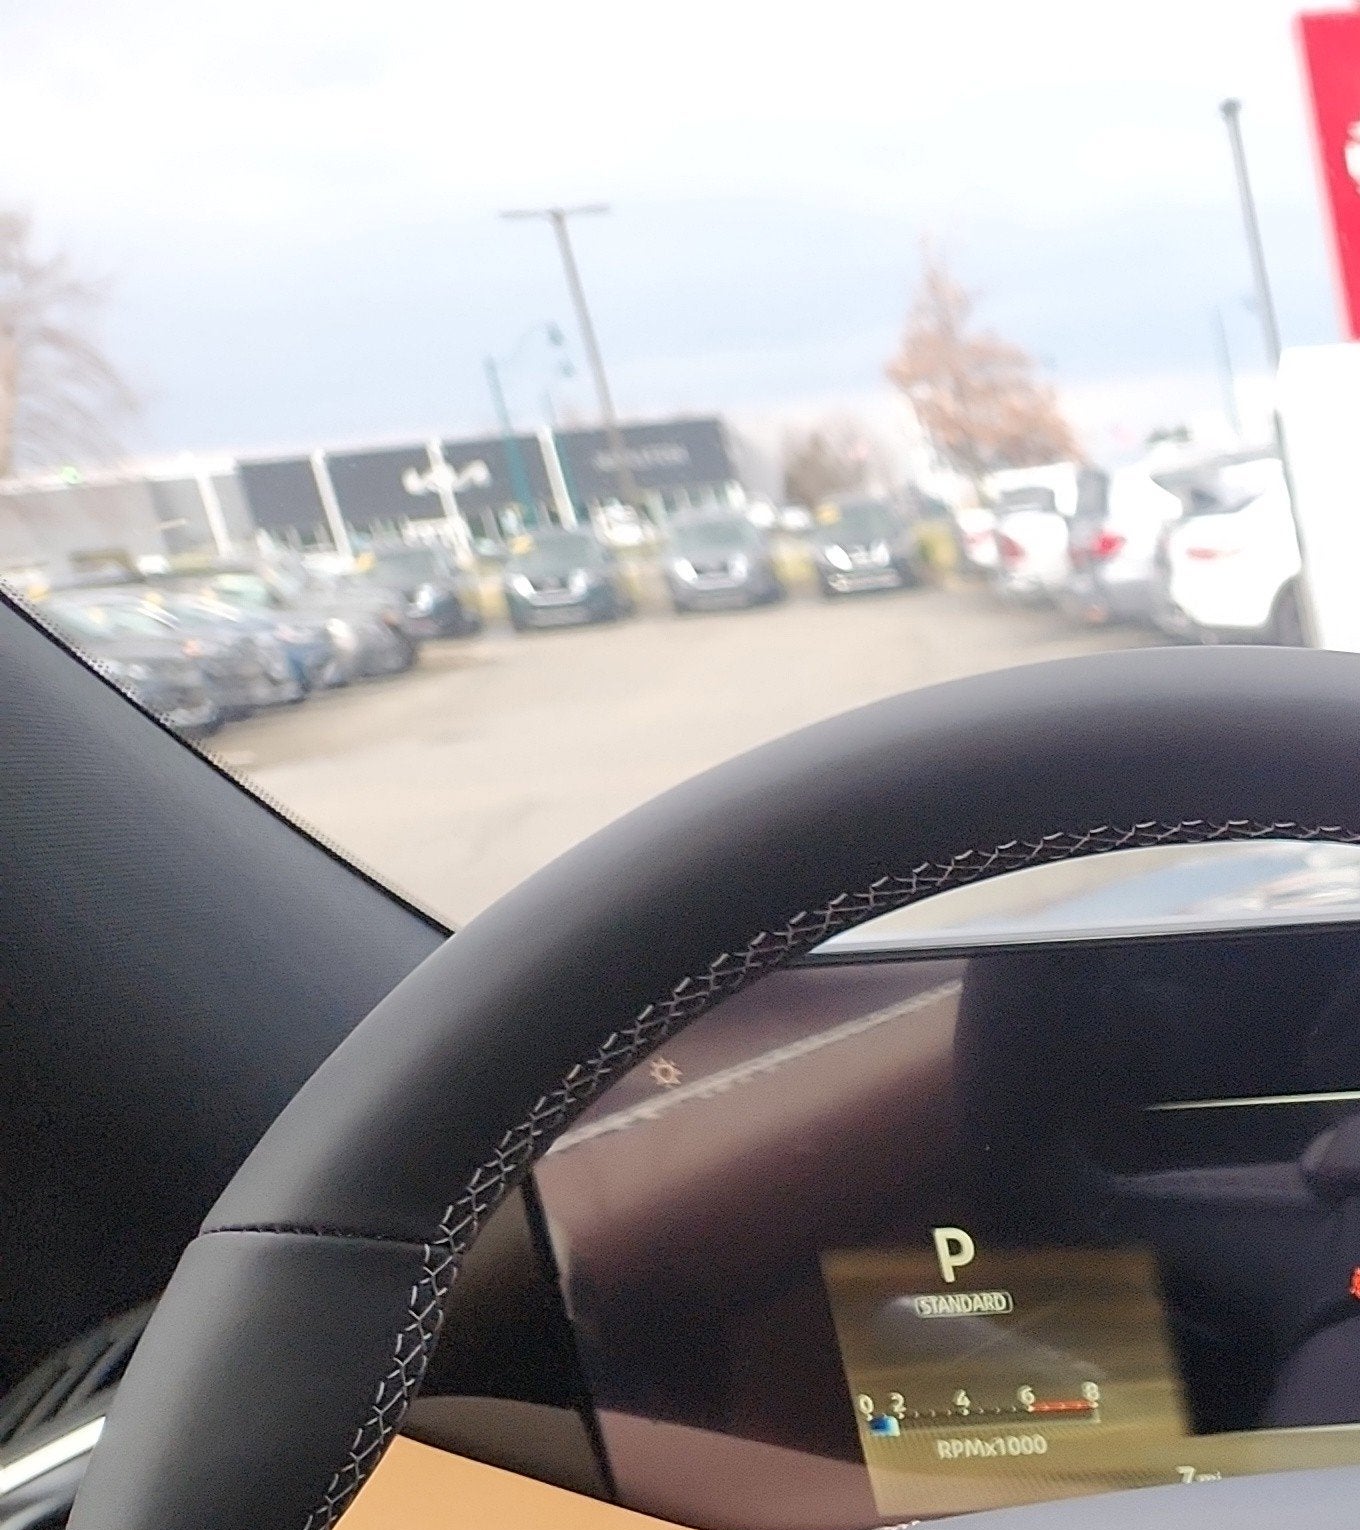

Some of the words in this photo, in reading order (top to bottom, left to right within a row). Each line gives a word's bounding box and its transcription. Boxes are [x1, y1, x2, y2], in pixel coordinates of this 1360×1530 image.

[933, 1227, 975, 1283] P
[919, 1292, 1007, 1315] STANDARD
[859, 1394, 873, 1414] 0
[891, 1392, 905, 1413] 2
[954, 1388, 970, 1409] 4
[1017, 1384, 1033, 1408] 6
[1082, 1381, 1098, 1403] 8
[938, 1434, 1047, 1459] RPMx1000
